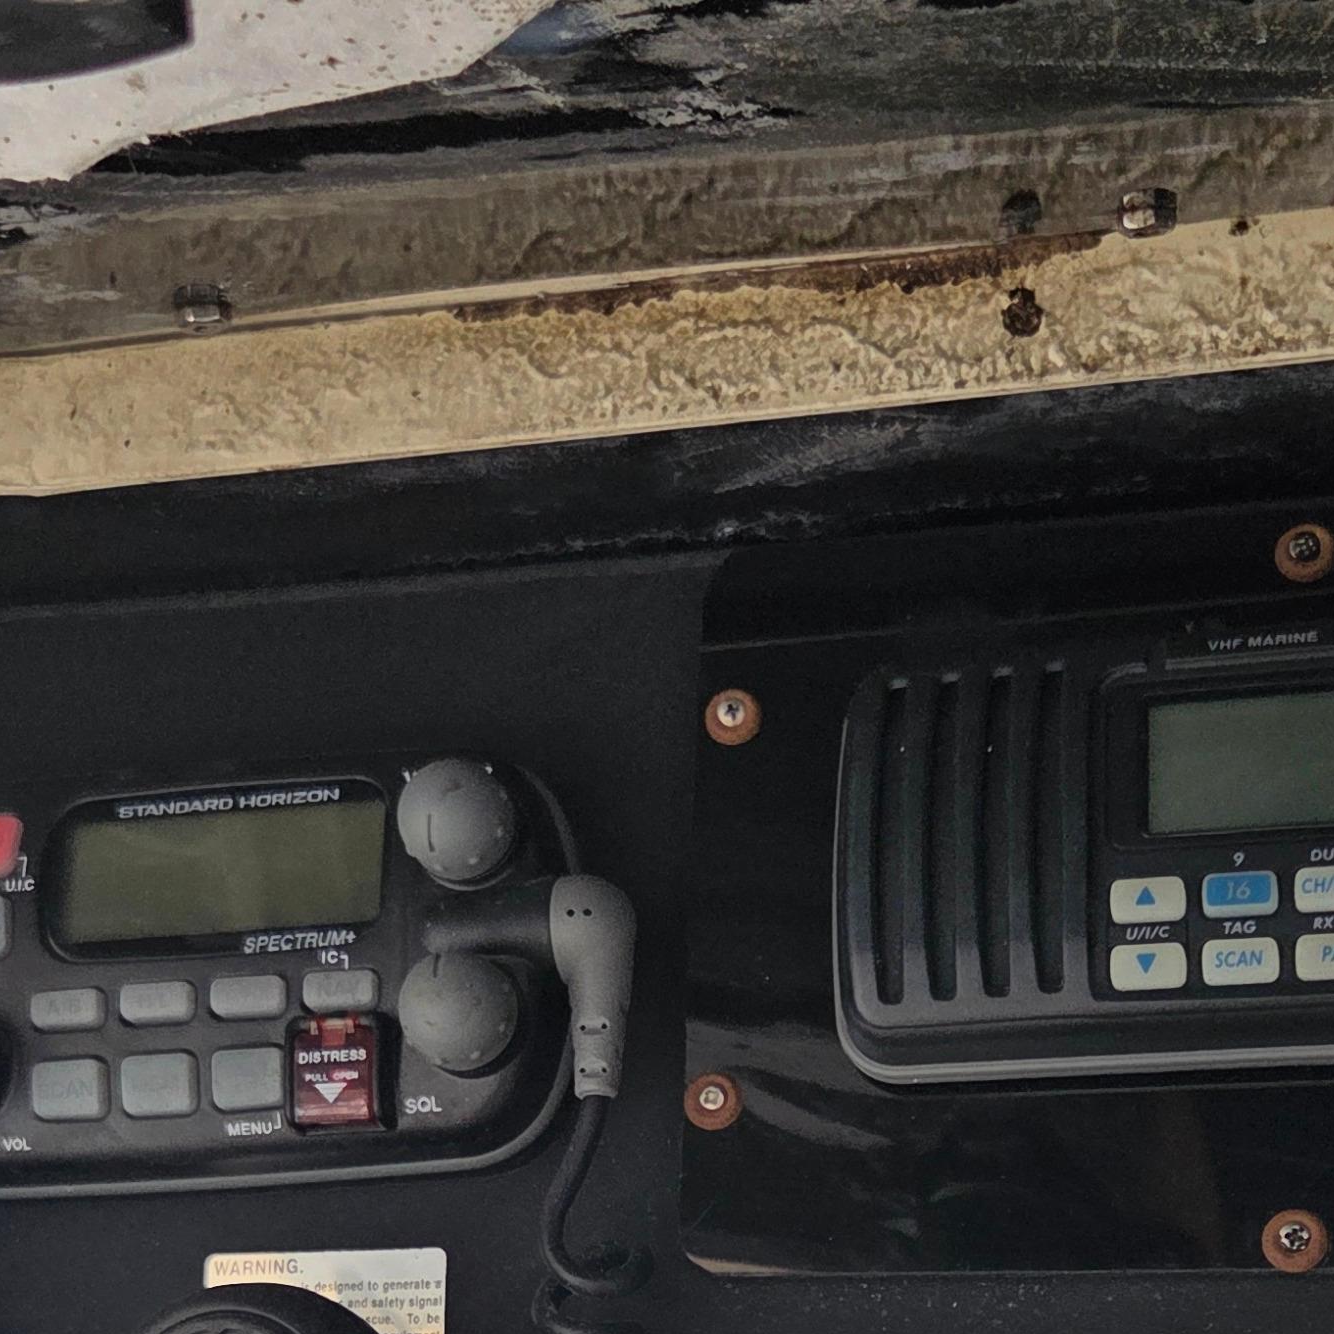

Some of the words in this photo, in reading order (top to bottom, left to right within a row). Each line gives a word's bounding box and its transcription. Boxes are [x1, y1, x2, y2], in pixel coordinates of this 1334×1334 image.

[1208, 637, 1244, 652] VHF
[1248, 631, 1319, 648] MARINE
[117, 798, 233, 820] STANDARD
[239, 788, 340, 809] HORIZON
[1233, 851, 1245, 868] 9
[1226, 879, 1251, 900] 16
[1223, 920, 1257, 935] TAG
[1312, 917, 1334, 931] RX
[1126, 926, 1170, 941] U/I/C
[243, 930, 357, 955] SPECTRUM+
[320, 950, 339, 965] IC
[1215, 949, 1263, 969] SCAN
[298, 1048, 367, 1065] DISTRESS
[304, 1072, 328, 1083] PULL
[332, 1070, 359, 1081] OPEN
[405, 1095, 442, 1115] SQL
[227, 1122, 273, 1137] MENU
[2, 1137, 33, 1152] VOL
[214, 1258, 304, 1277] WARNING.
[314, 1278, 364, 1294] designed
[367, 1278, 379, 1291] to
[383, 1277, 430, 1294] generate
[347, 1297, 368, 1309] and
[371, 1296, 405, 1311] safety
[409, 1295, 442, 1310] signal
[406, 1312, 421, 1325] To
[426, 1312, 441, 1325] be
